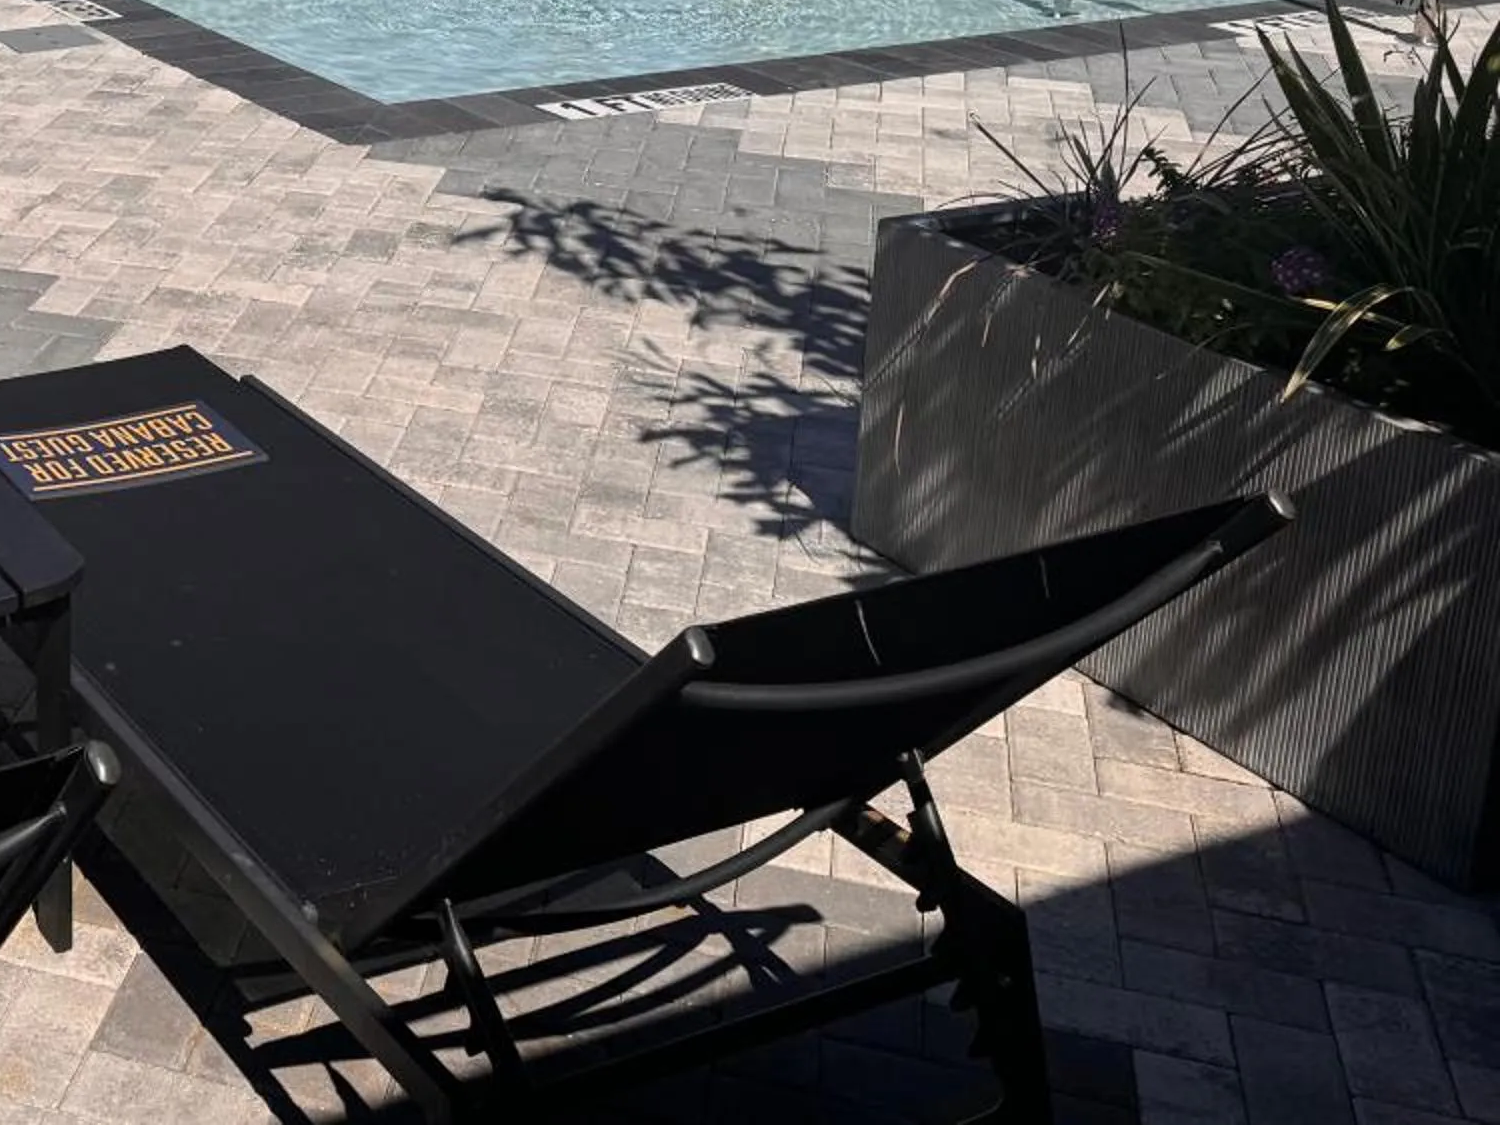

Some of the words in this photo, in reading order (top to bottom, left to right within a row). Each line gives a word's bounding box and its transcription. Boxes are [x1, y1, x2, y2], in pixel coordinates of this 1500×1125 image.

[89, 411, 213, 448] CABANA
[0, 434, 92, 462] GUEST
[85, 432, 232, 474] RESERVED
[23, 459, 88, 483] FOR
